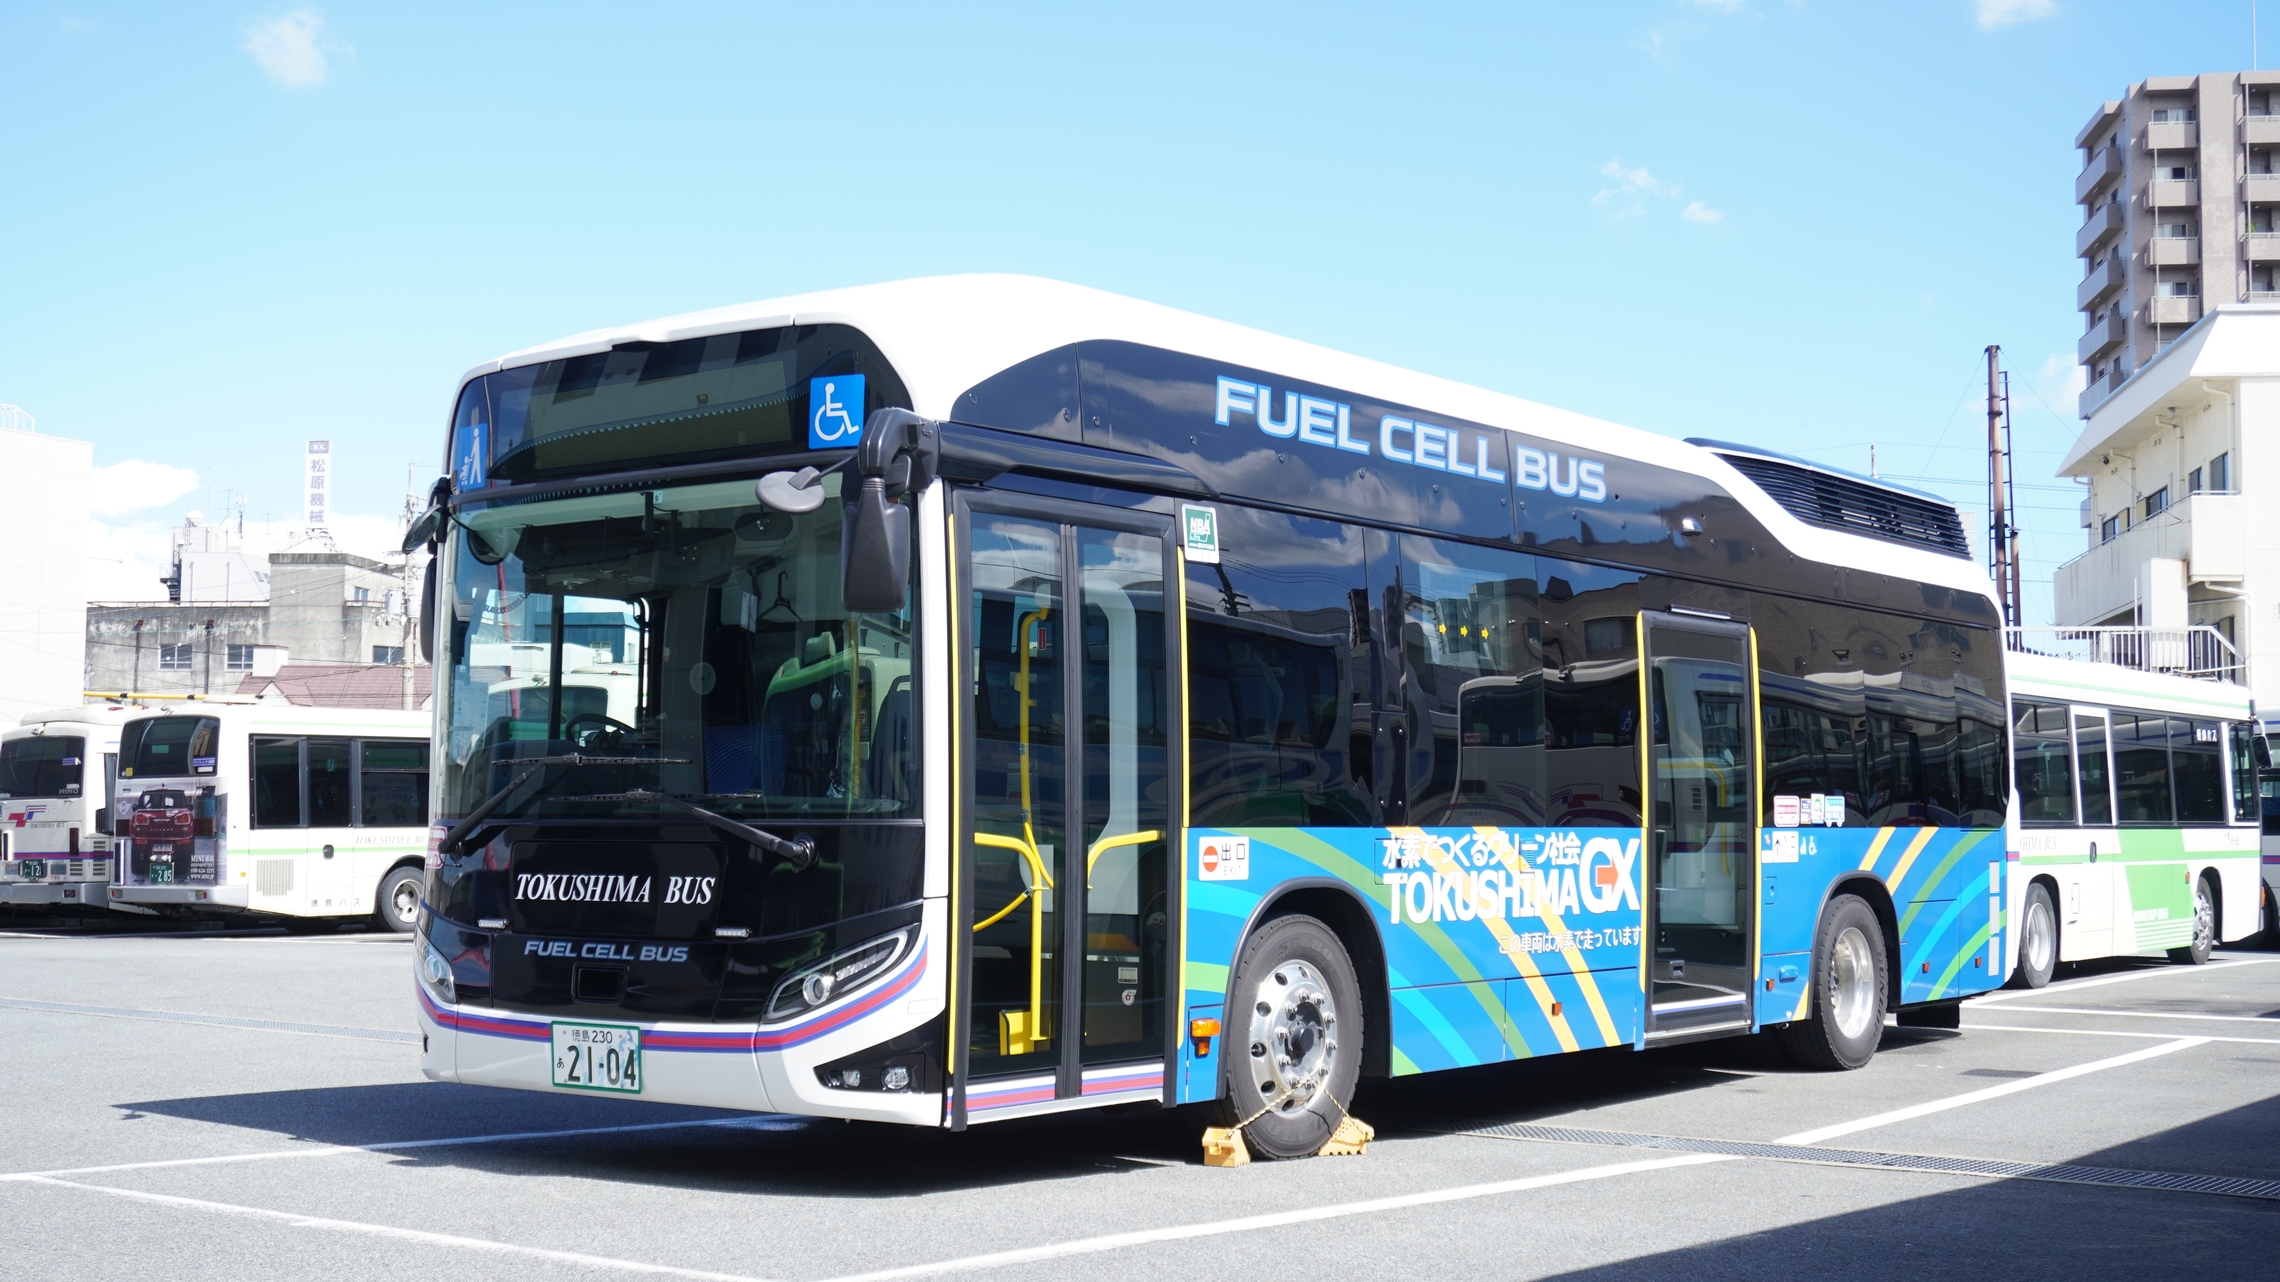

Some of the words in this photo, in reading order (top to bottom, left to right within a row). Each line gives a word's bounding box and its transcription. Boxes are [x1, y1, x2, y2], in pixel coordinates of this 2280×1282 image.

[1215, 375, 1370, 455] FUEL
[1380, 414, 1505, 484] CELL
[1516, 445, 1607, 502] BUS
[309, 459, 326, 524] 松原機械
[1190, 517, 1210, 533] NBA
[355, 836, 410, 845] TOKUSHIMA
[415, 835, 426, 844] BU
[1382, 831, 1581, 869] 水素でつくるグリーン社会
[2019, 836, 2042, 851] SHIMA
[2044, 835, 2057, 851] BUS
[1221, 842, 1245, 861] 出口
[1224, 865, 1242, 876] EXIT
[1383, 869, 1580, 924] TOKUSHIMA
[1579, 837, 1640, 914] GX
[514, 873, 652, 904] TOKUSHIMA
[663, 876, 716, 905] BUS
[310, 898, 361, 908] 徳島バス
[2134, 909, 2157, 922] NONSTEP
[2158, 908, 2168, 920] BUS
[1498, 926, 1641, 955] この車両は水素で走っています
[523, 940, 577, 958] FUEL
[580, 943, 634, 961] CELL
[639, 945, 689, 963] BUS
[572, 1029, 590, 1043] 徳島
[592, 1030, 612, 1043] 230
[557, 1057, 564, 1069] あ
[567, 1045, 636, 1087] 21-04
